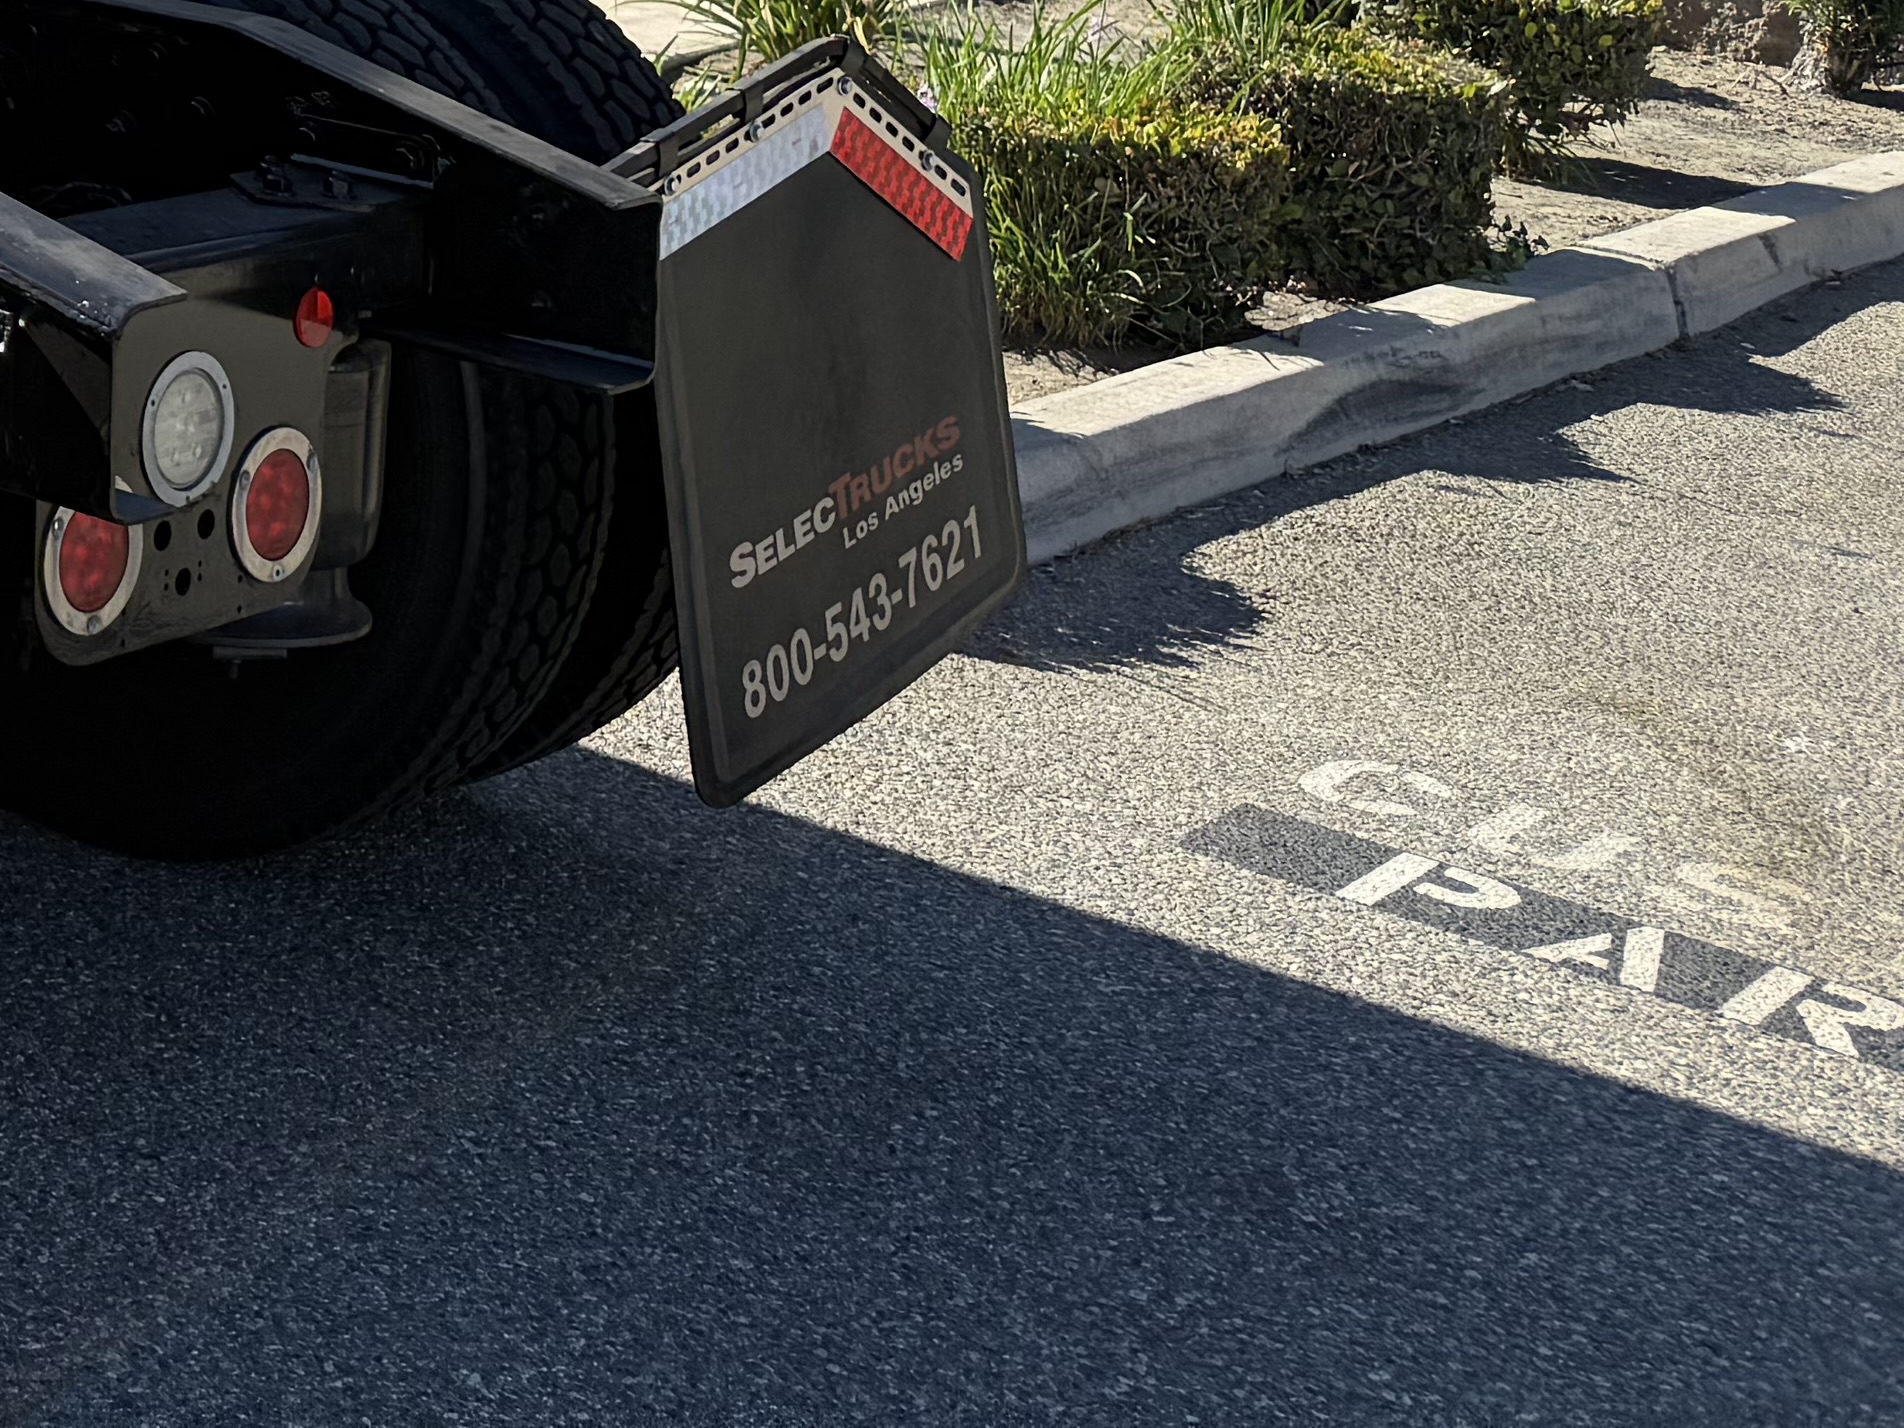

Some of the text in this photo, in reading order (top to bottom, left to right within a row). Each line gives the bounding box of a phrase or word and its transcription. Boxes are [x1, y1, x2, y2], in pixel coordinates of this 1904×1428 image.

[729, 414, 961, 589] SELECTRUCKS
[841, 452, 964, 549] Los Angeles
[741, 504, 982, 719] 800-543-7621
